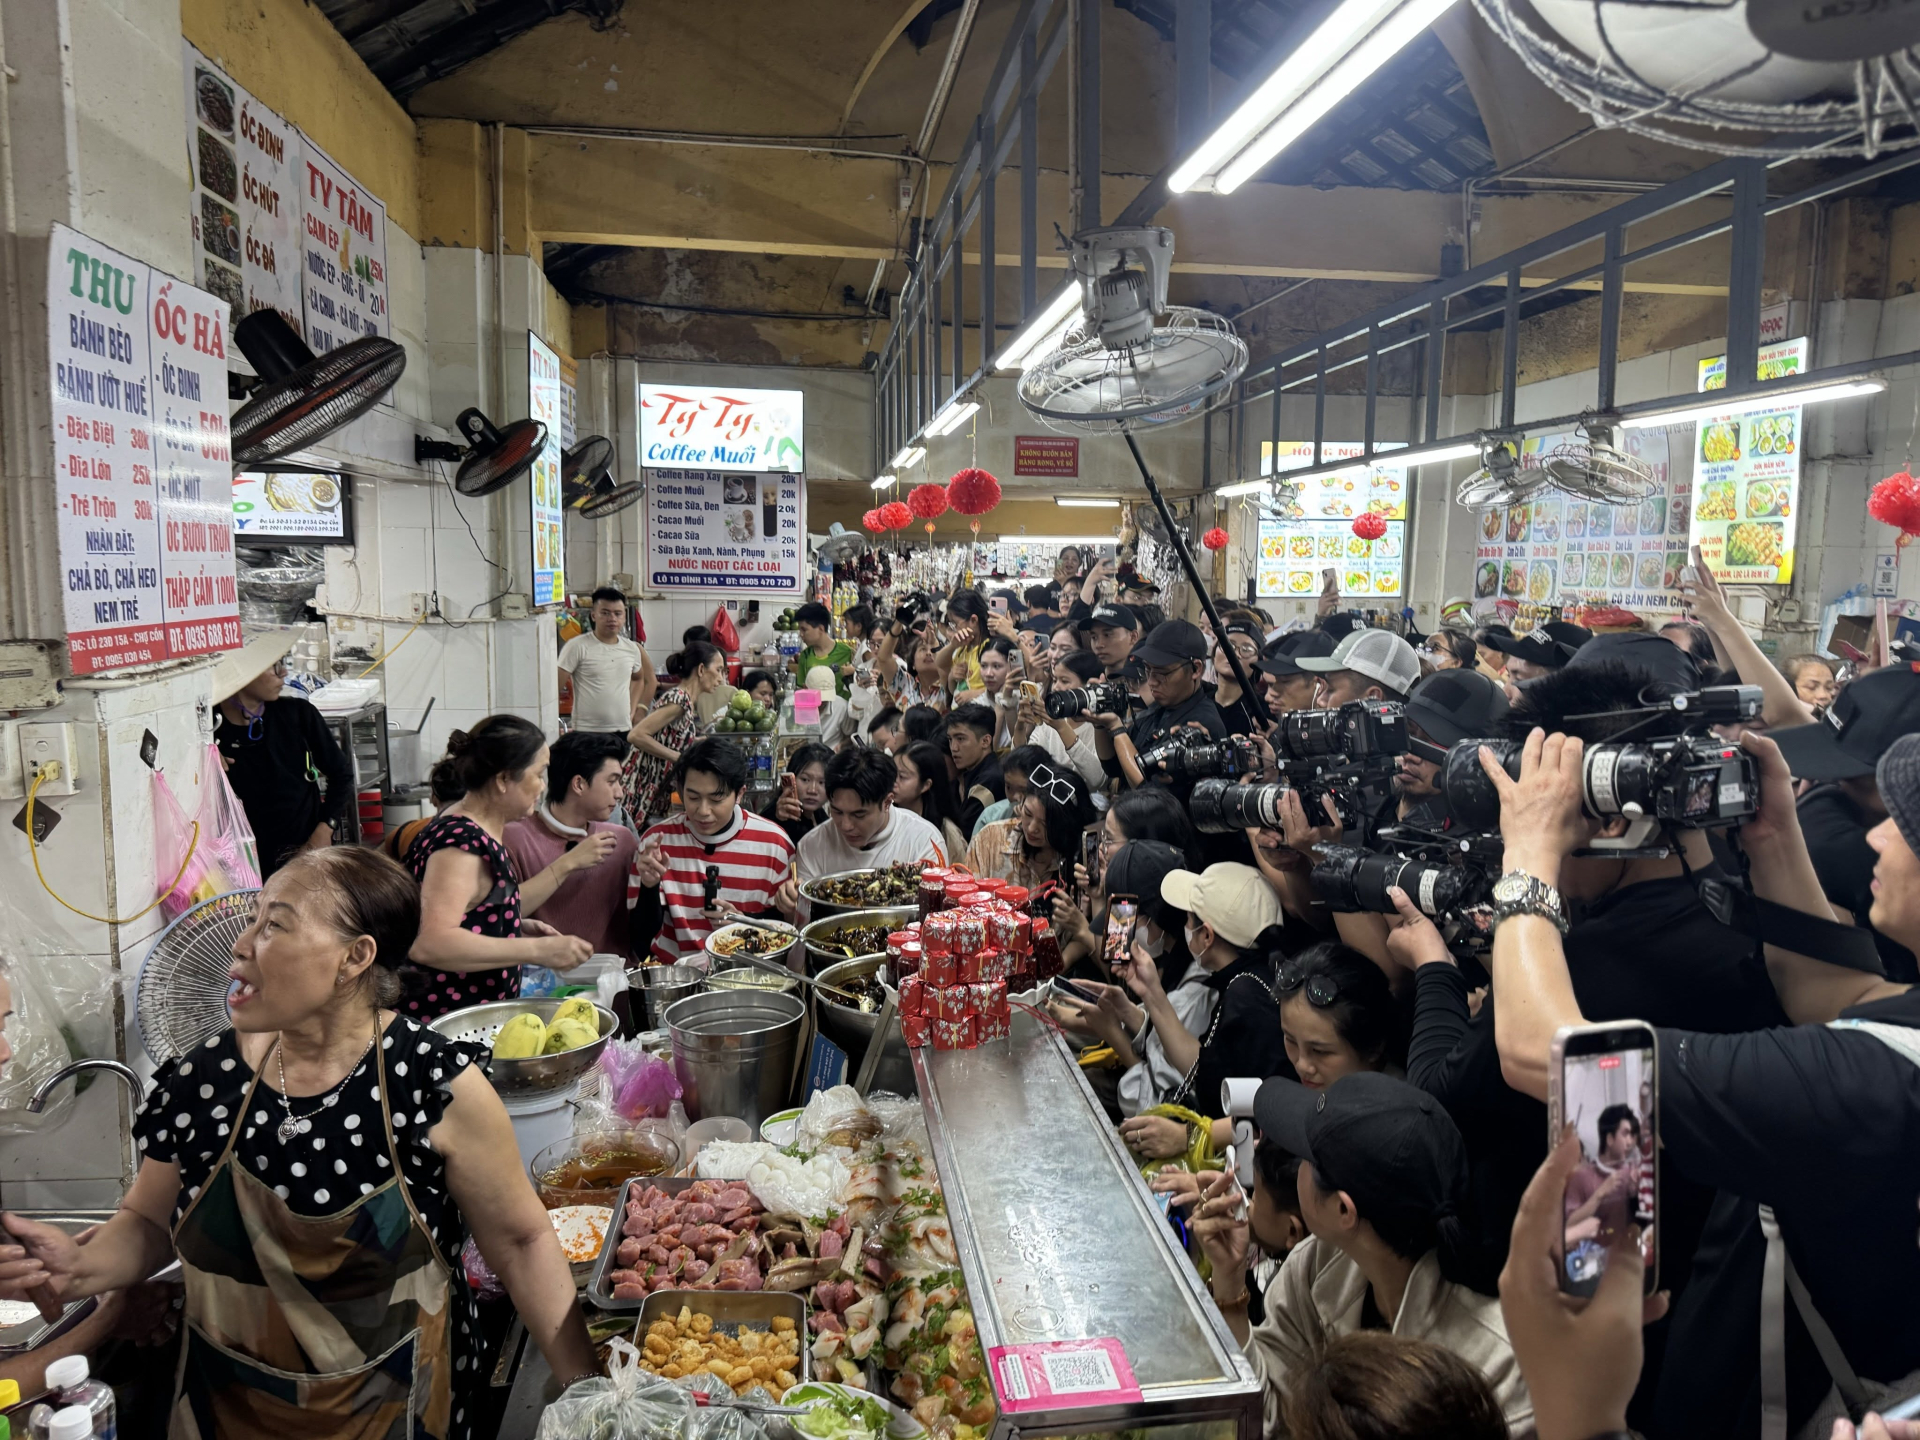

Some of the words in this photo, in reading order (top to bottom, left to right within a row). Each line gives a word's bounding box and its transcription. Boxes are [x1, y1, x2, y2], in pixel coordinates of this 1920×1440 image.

[257, 122, 283, 164] ĐINH
[259, 181, 279, 218] HÚT
[306, 160, 333, 209] TY
[336, 188, 374, 242] TÂM
[307, 212, 327, 245] CAM
[67, 247, 136, 315] THU
[155, 281, 187, 345] ỐC
[193, 309, 225, 359] HÀ
[70, 310, 105, 357] BÁNH
[108, 322, 132, 365] BÈO
[57, 358, 95, 405] BÁNH
[162, 352, 175, 396] ỐC
[642, 393, 698, 438] Ty
[699, 396, 755, 440] Ty
[648, 443, 706, 463] Coffee
[1020, 449, 1041, 457] KHÔNG
[132, 464, 152, 485] 25k
[657, 469, 682, 479] Coffee
[684, 470, 705, 481] Rang
[706, 471, 721, 481] Xay
[781, 475, 796, 484] 20k
[657, 485, 682, 495] Coffee
[781, 489, 796, 499] 20k
[134, 499, 153, 520] 30k
[657, 500, 683, 510] Coffee
[778, 505, 796, 513] 20k
[657, 515, 682, 525] Cacao
[781, 519, 796, 528] 20k
[86, 527, 113, 555] NHẬN
[657, 530, 683, 540] Cacao
[781, 536, 796, 544] 20k
[668, 558, 698, 569] NƯỚC
[701, 560, 729, 572] NGỌT
[732, 560, 754, 571] CÁC
[757, 562, 781, 573] LOẠI
[741, 548, 765, 559] Phụng
[781, 549, 796, 558] 15k
[68, 561, 92, 591] CHẢ
[115, 561, 136, 589] CHẢ
[137, 567, 157, 588] HEO
[165, 570, 190, 614] THẬP
[1645, 595, 1668, 607] NEM
[94, 600, 119, 624] NEM
[185, 625, 207, 651] 0935
[223, 621, 239, 644] 312
